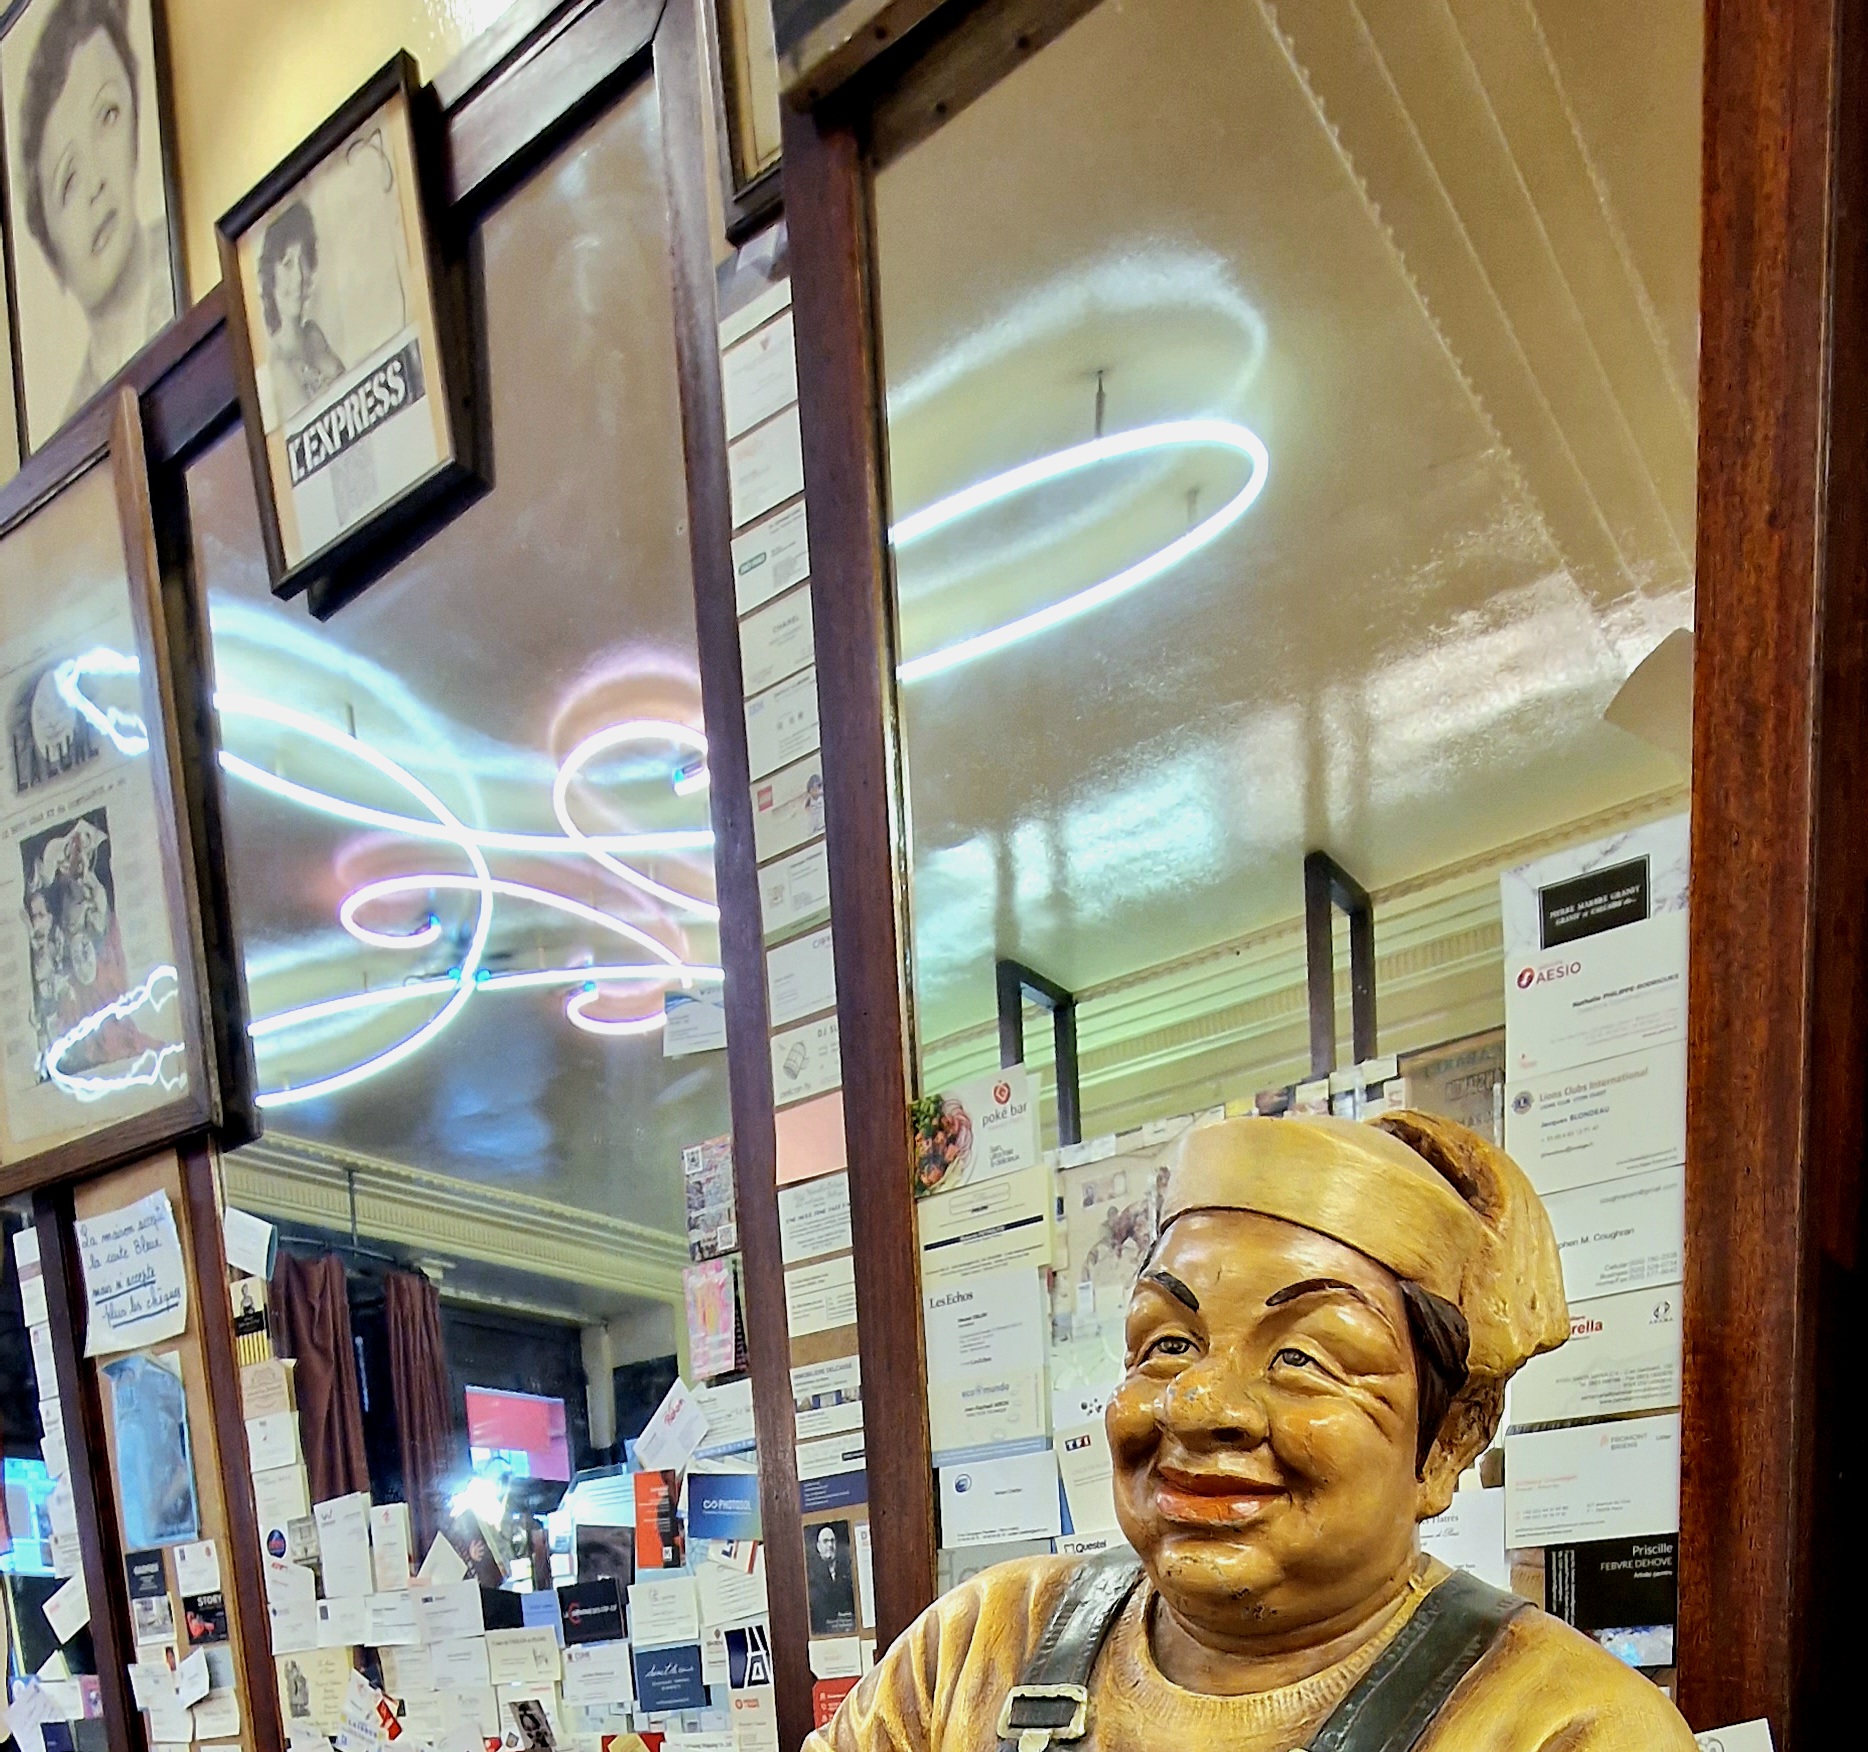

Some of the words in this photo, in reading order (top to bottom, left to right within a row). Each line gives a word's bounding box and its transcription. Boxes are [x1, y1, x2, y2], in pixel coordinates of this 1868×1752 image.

[288, 360, 407, 484] L'EXPRESS
[1536, 961, 1582, 985] AESIO
[1539, 1092, 1563, 1103] Lions
[1564, 1081, 1588, 1097] Clubs
[1588, 1067, 1650, 1091] International
[982, 1108, 1008, 1127] poké
[1010, 1101, 1028, 1117] bar
[1569, 1106, 1610, 1122] BLONDEAU
[1580, 1236, 1592, 1244] M.
[1593, 1226, 1635, 1243] Coughran
[929, 1297, 946, 1310] Les
[945, 1291, 975, 1306] Echos
[1571, 1319, 1604, 1336] rella
[1075, 1540, 1107, 1554] Questel
[1632, 1543, 1674, 1557] Priscille
[196, 1593, 223, 1608] STORY
